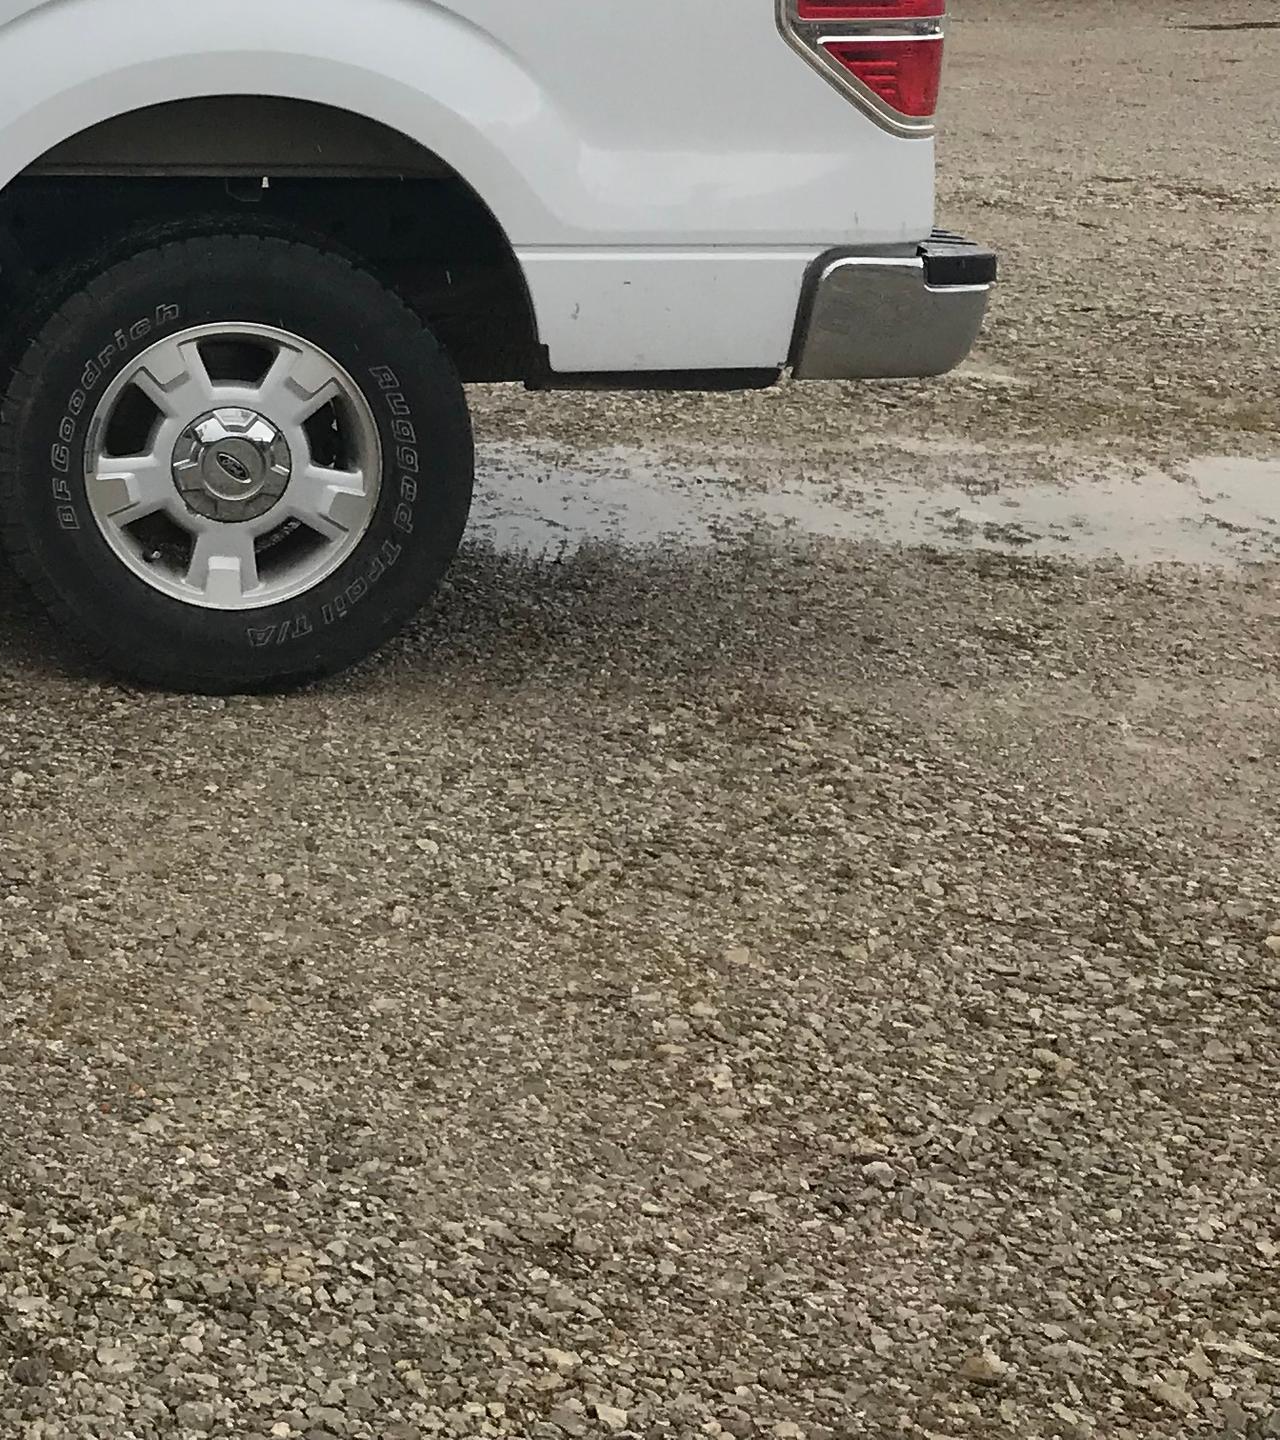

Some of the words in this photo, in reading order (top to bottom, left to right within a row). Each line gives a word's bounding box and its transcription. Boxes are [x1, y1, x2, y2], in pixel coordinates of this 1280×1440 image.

[51, 303, 180, 531] BFGoodrich
[368, 364, 420, 534] Rugged
[246, 615, 313, 648] T/A
[320, 540, 403, 626] Trail
